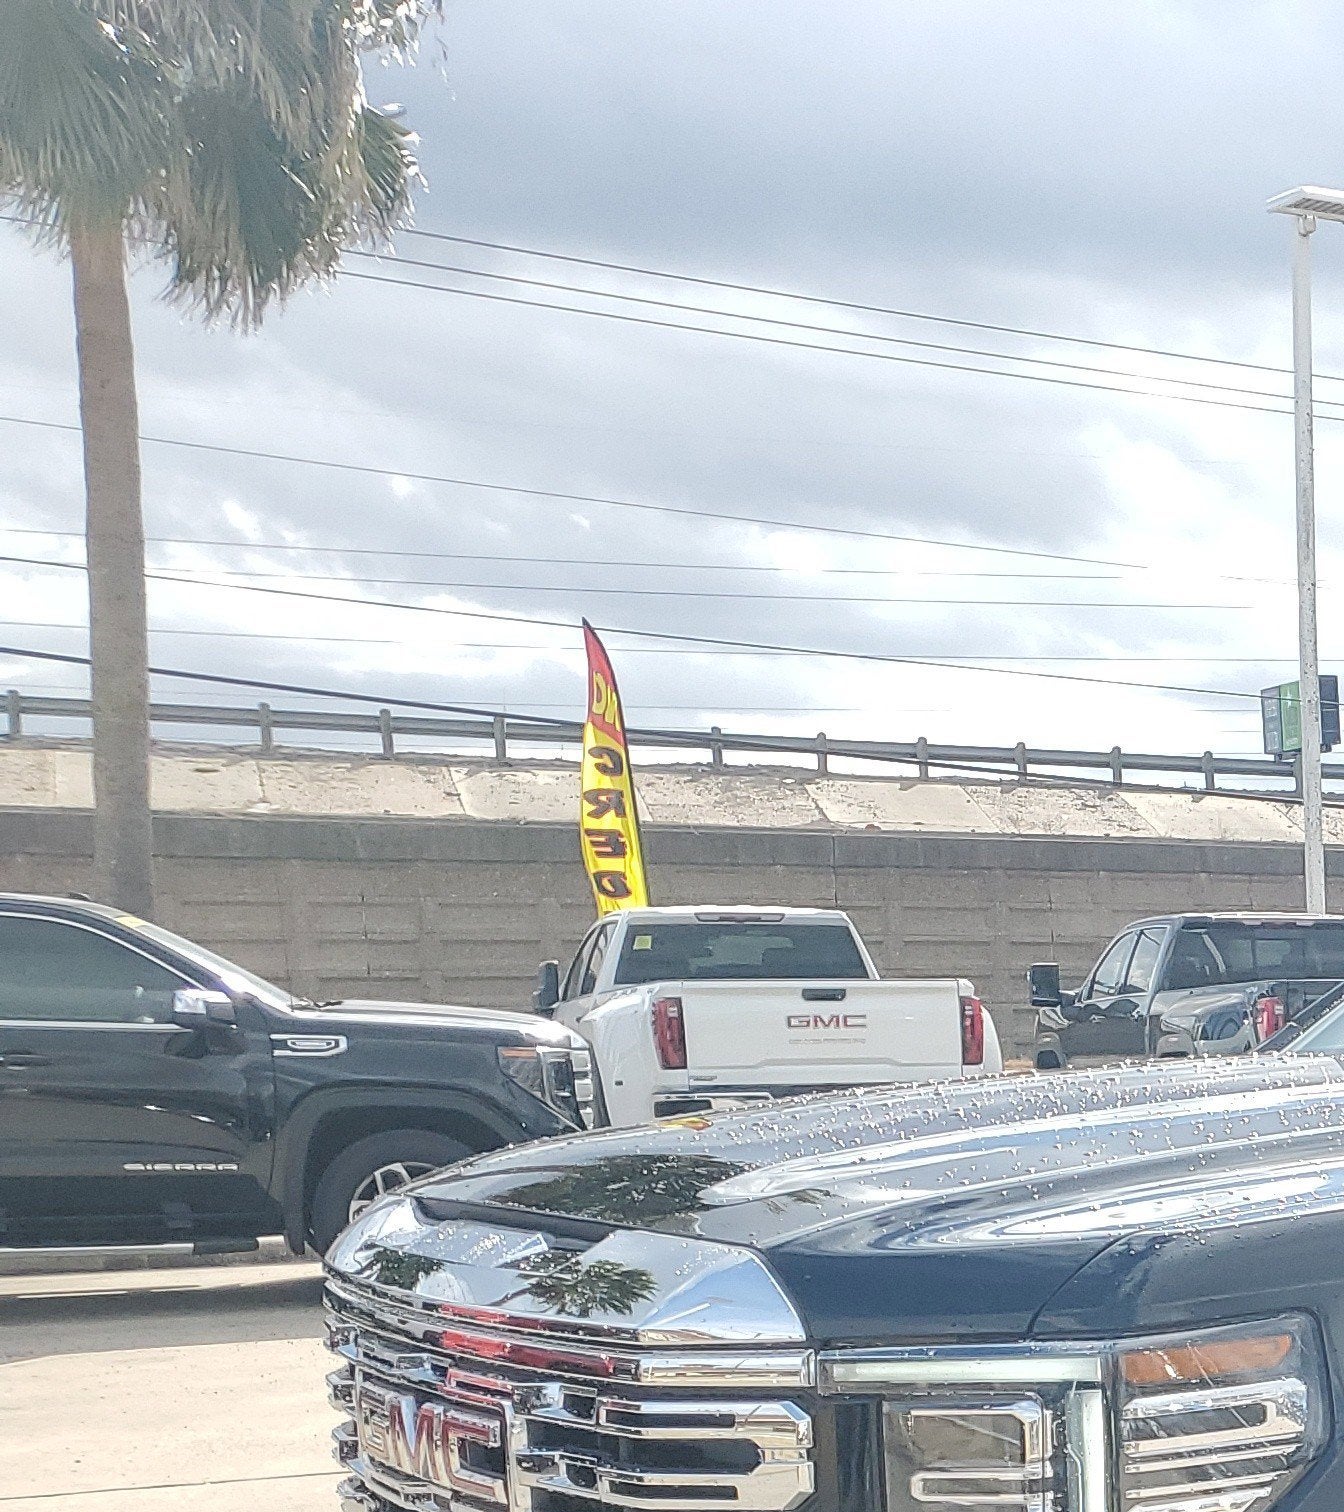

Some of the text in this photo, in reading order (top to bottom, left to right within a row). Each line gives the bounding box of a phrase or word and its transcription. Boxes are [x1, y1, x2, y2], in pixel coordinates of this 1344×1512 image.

[786, 1014, 868, 1029] GMC
[122, 1162, 240, 1172] SIERRA
[358, 1380, 509, 1507] GMC
